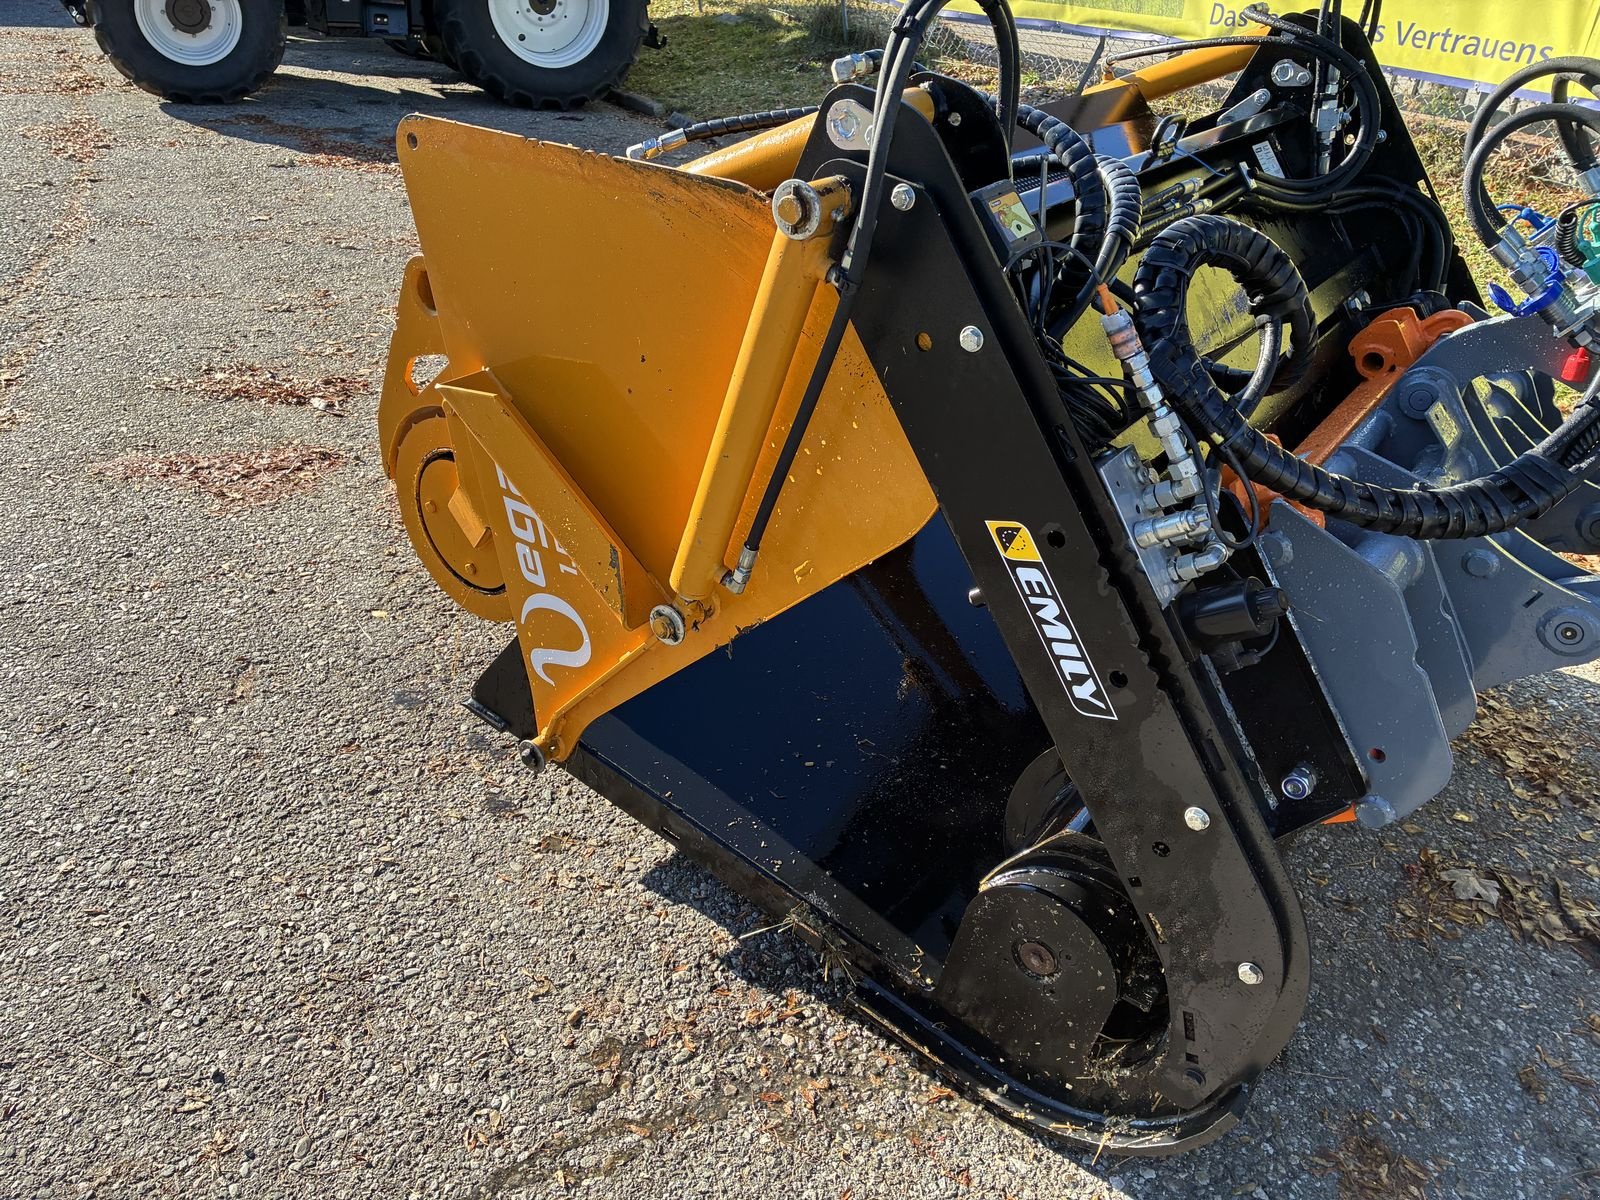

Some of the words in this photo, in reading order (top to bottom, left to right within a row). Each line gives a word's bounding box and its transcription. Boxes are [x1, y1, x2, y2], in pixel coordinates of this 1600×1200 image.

[1209, 2, 1249, 27] Das
[1396, 20, 1554, 65] Vertrauens
[1015, 566, 1107, 710] EMILY
